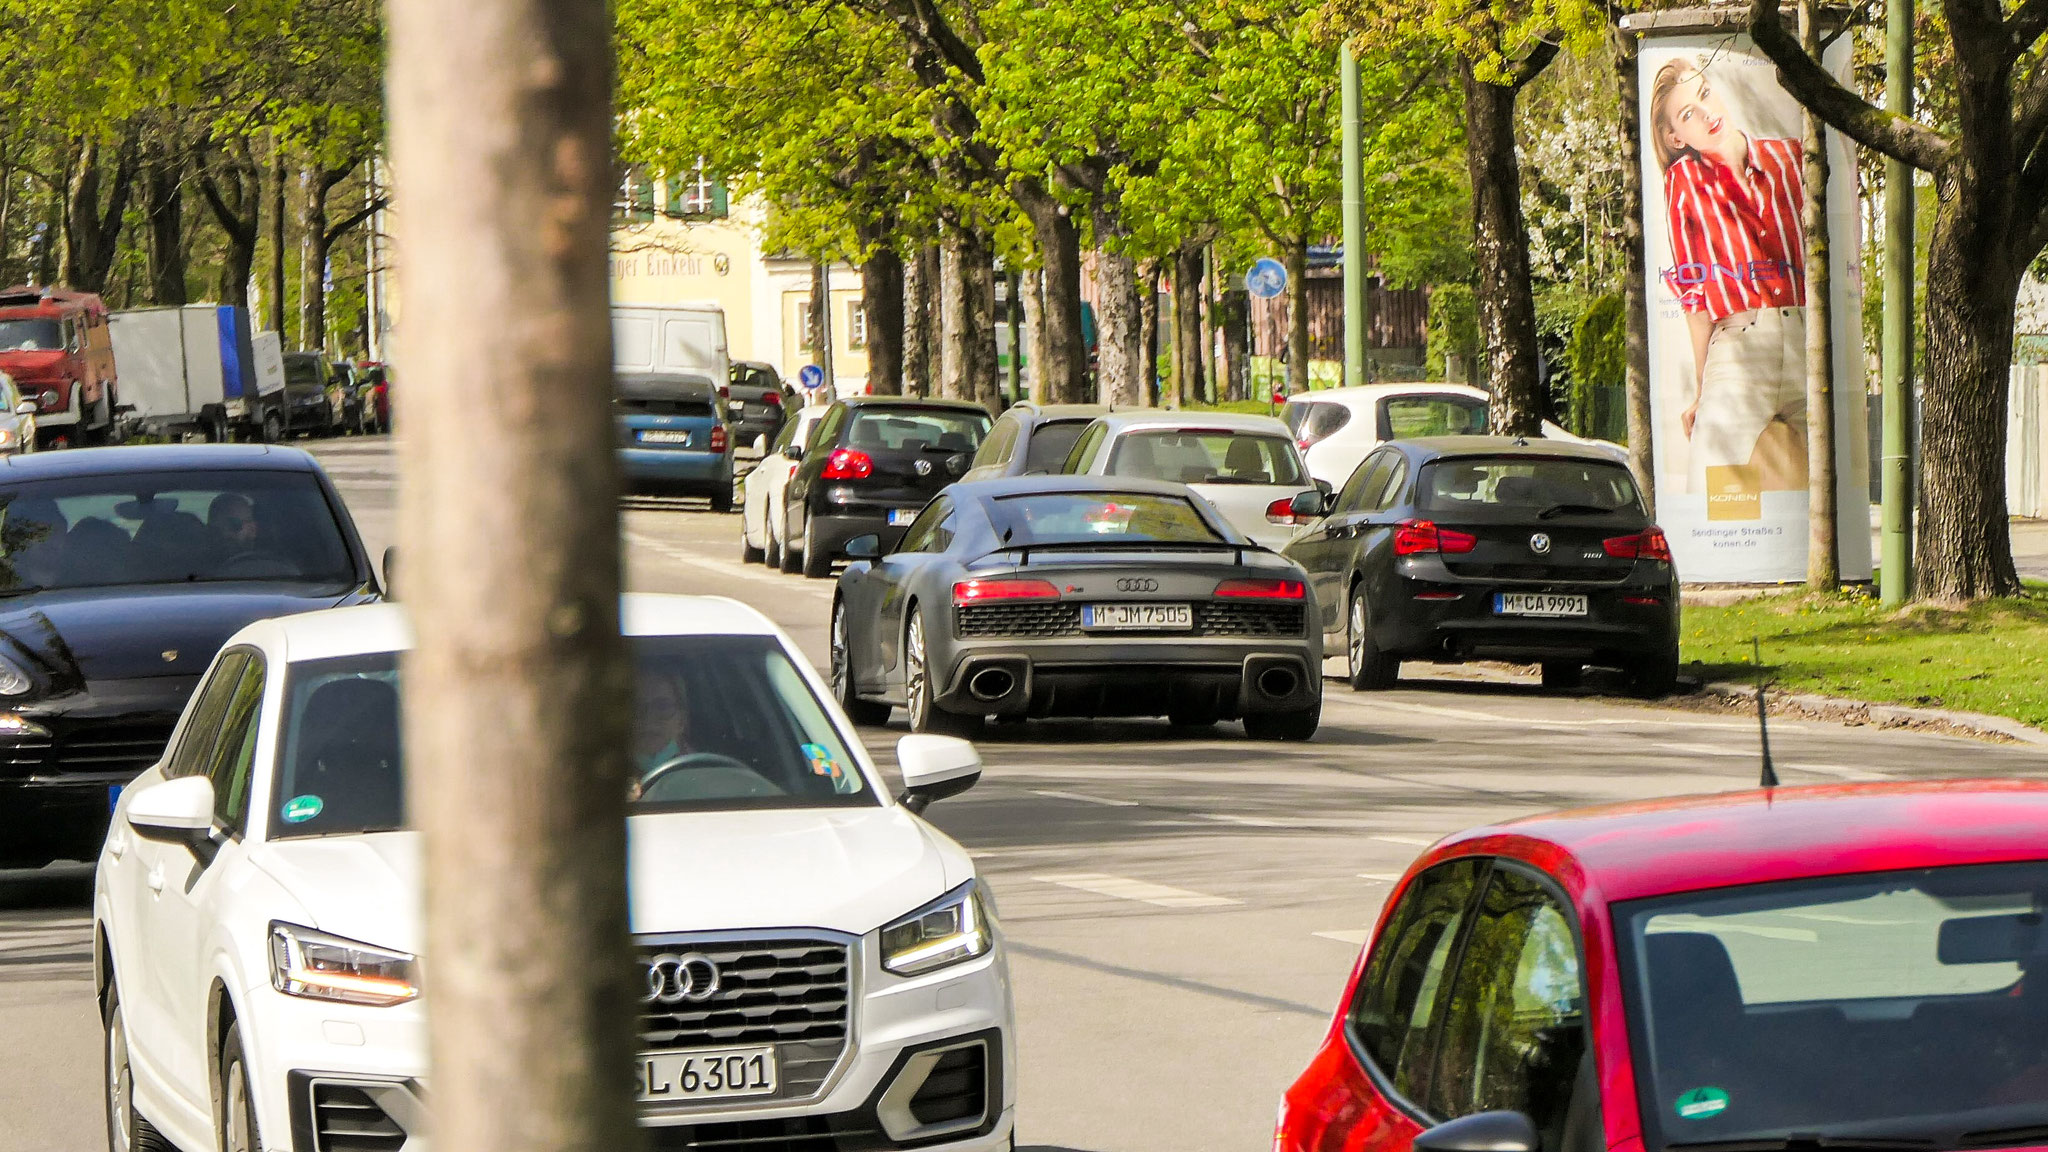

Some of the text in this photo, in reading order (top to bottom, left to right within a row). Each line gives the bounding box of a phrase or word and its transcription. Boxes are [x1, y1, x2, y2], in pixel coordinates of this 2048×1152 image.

[647, 253, 703, 276] Einkehr
[1709, 494, 1758, 502] KONEN
[1691, 528, 1738, 537] Sendlinger
[679, 1054, 770, 1093] 6301
